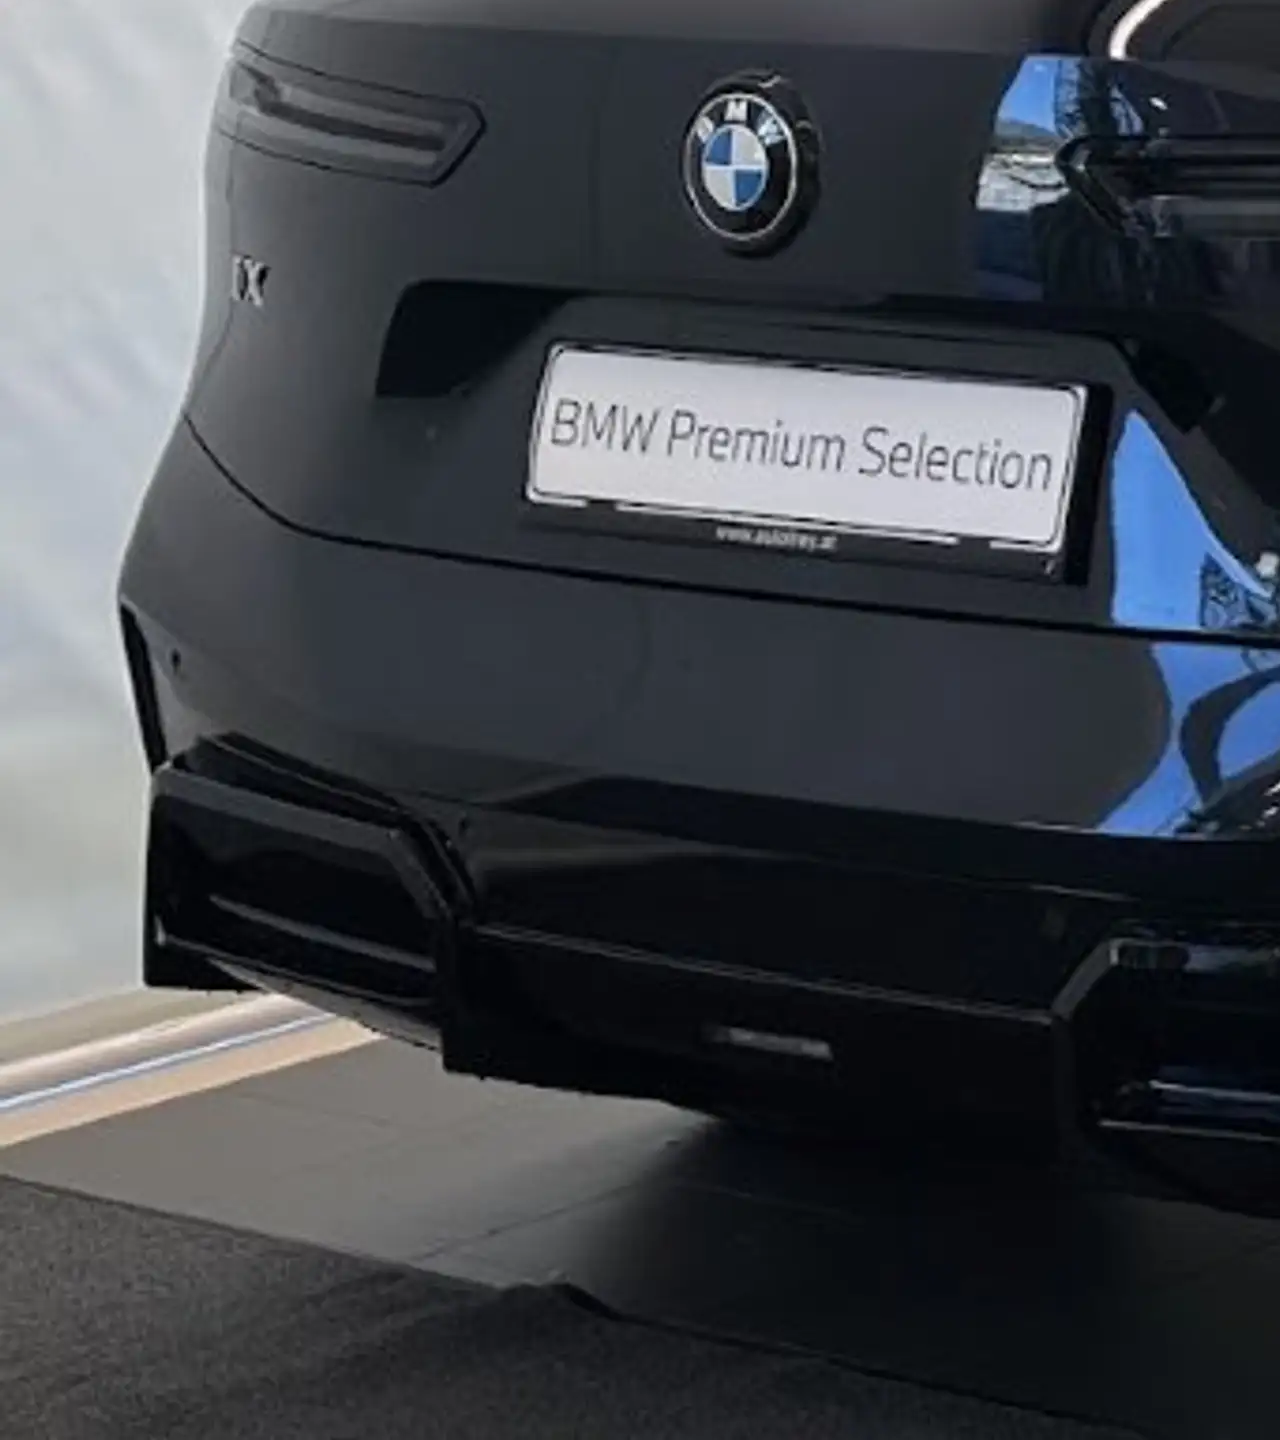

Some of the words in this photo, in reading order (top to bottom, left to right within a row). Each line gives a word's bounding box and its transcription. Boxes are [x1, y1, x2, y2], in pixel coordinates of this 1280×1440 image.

[695, 98, 786, 147] BMW
[550, 398, 660, 455] BMW
[667, 409, 847, 474] Premium
[857, 425, 1054, 493] Selection
